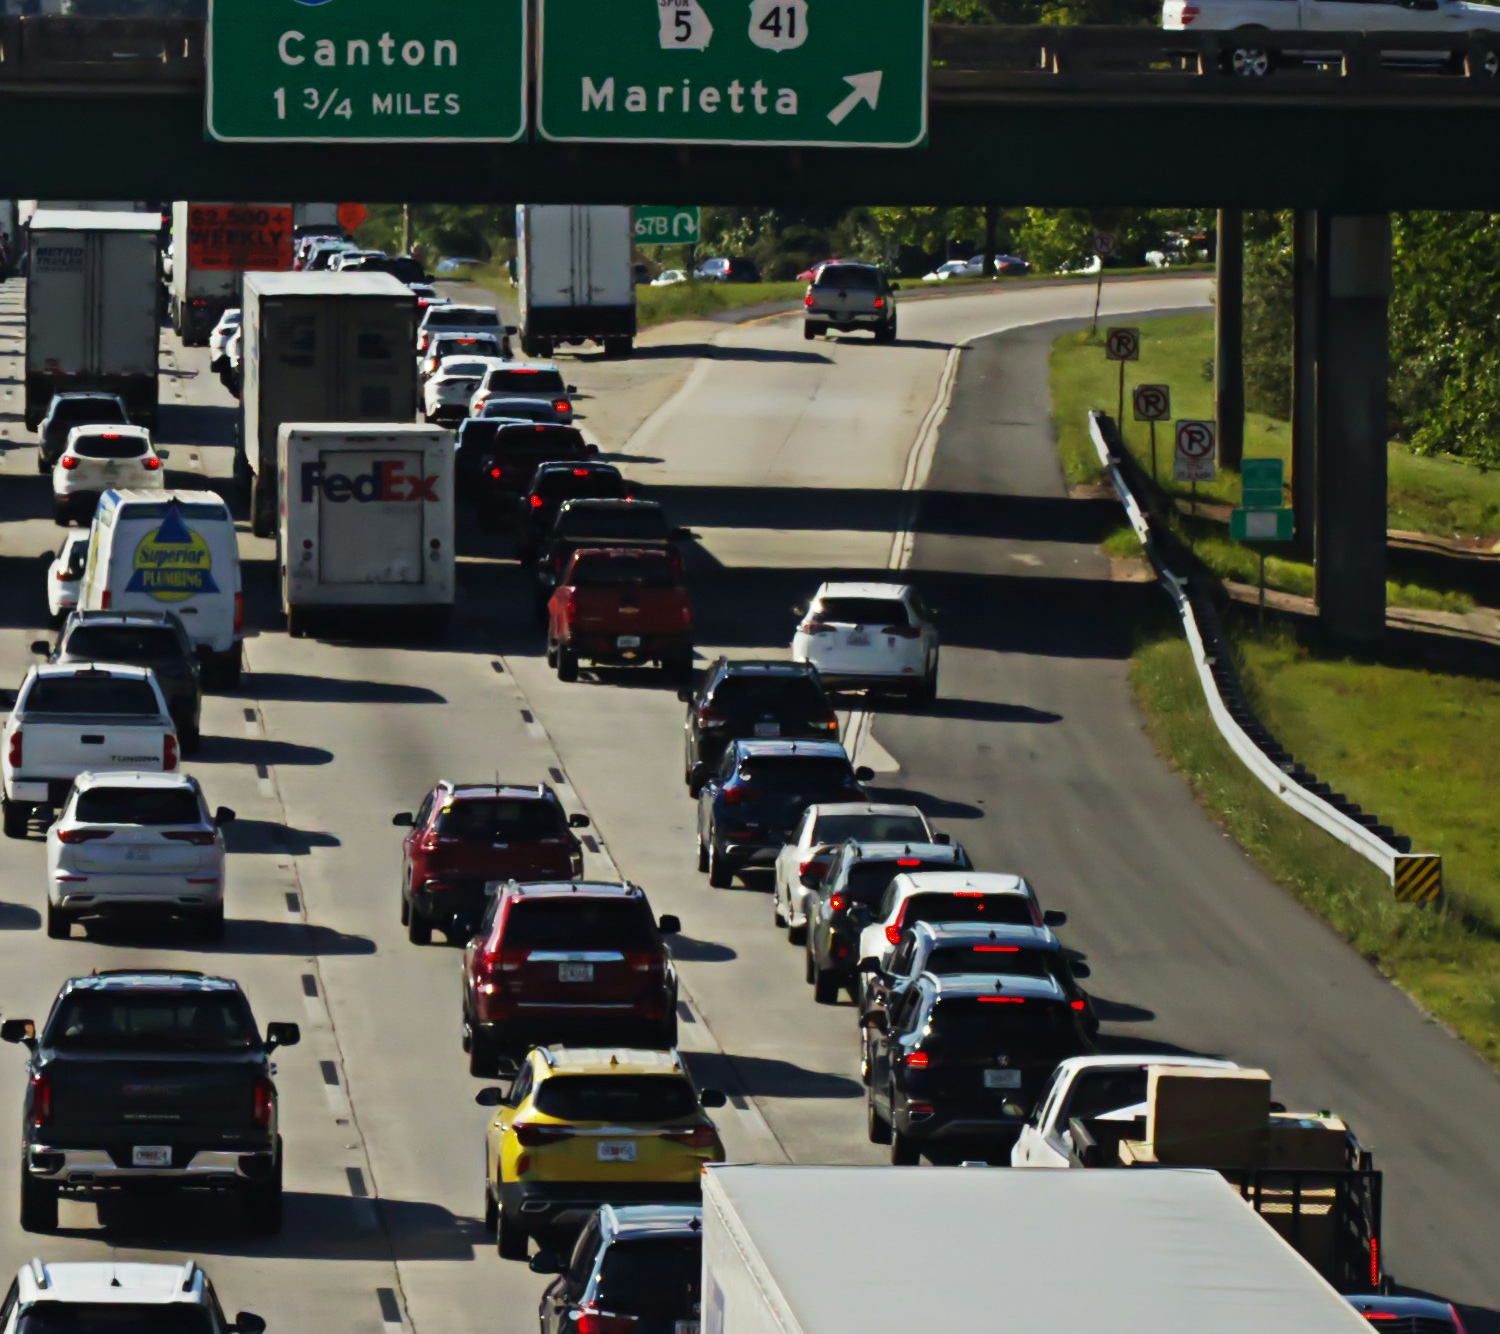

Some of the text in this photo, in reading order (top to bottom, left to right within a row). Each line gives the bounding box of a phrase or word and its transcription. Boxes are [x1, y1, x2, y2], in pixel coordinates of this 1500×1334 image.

[674, 11, 691, 42] 5
[758, 7, 798, 38] 41
[278, 30, 459, 66] Canton
[274, 89, 286, 120] 1
[372, 92, 460, 115] MILES
[582, 77, 799, 115] Marietta
[635, 216, 668, 235] 67B
[37, 248, 83, 257] METRO
[302, 460, 440, 503] FedEx
[140, 547, 205, 567] Superior
